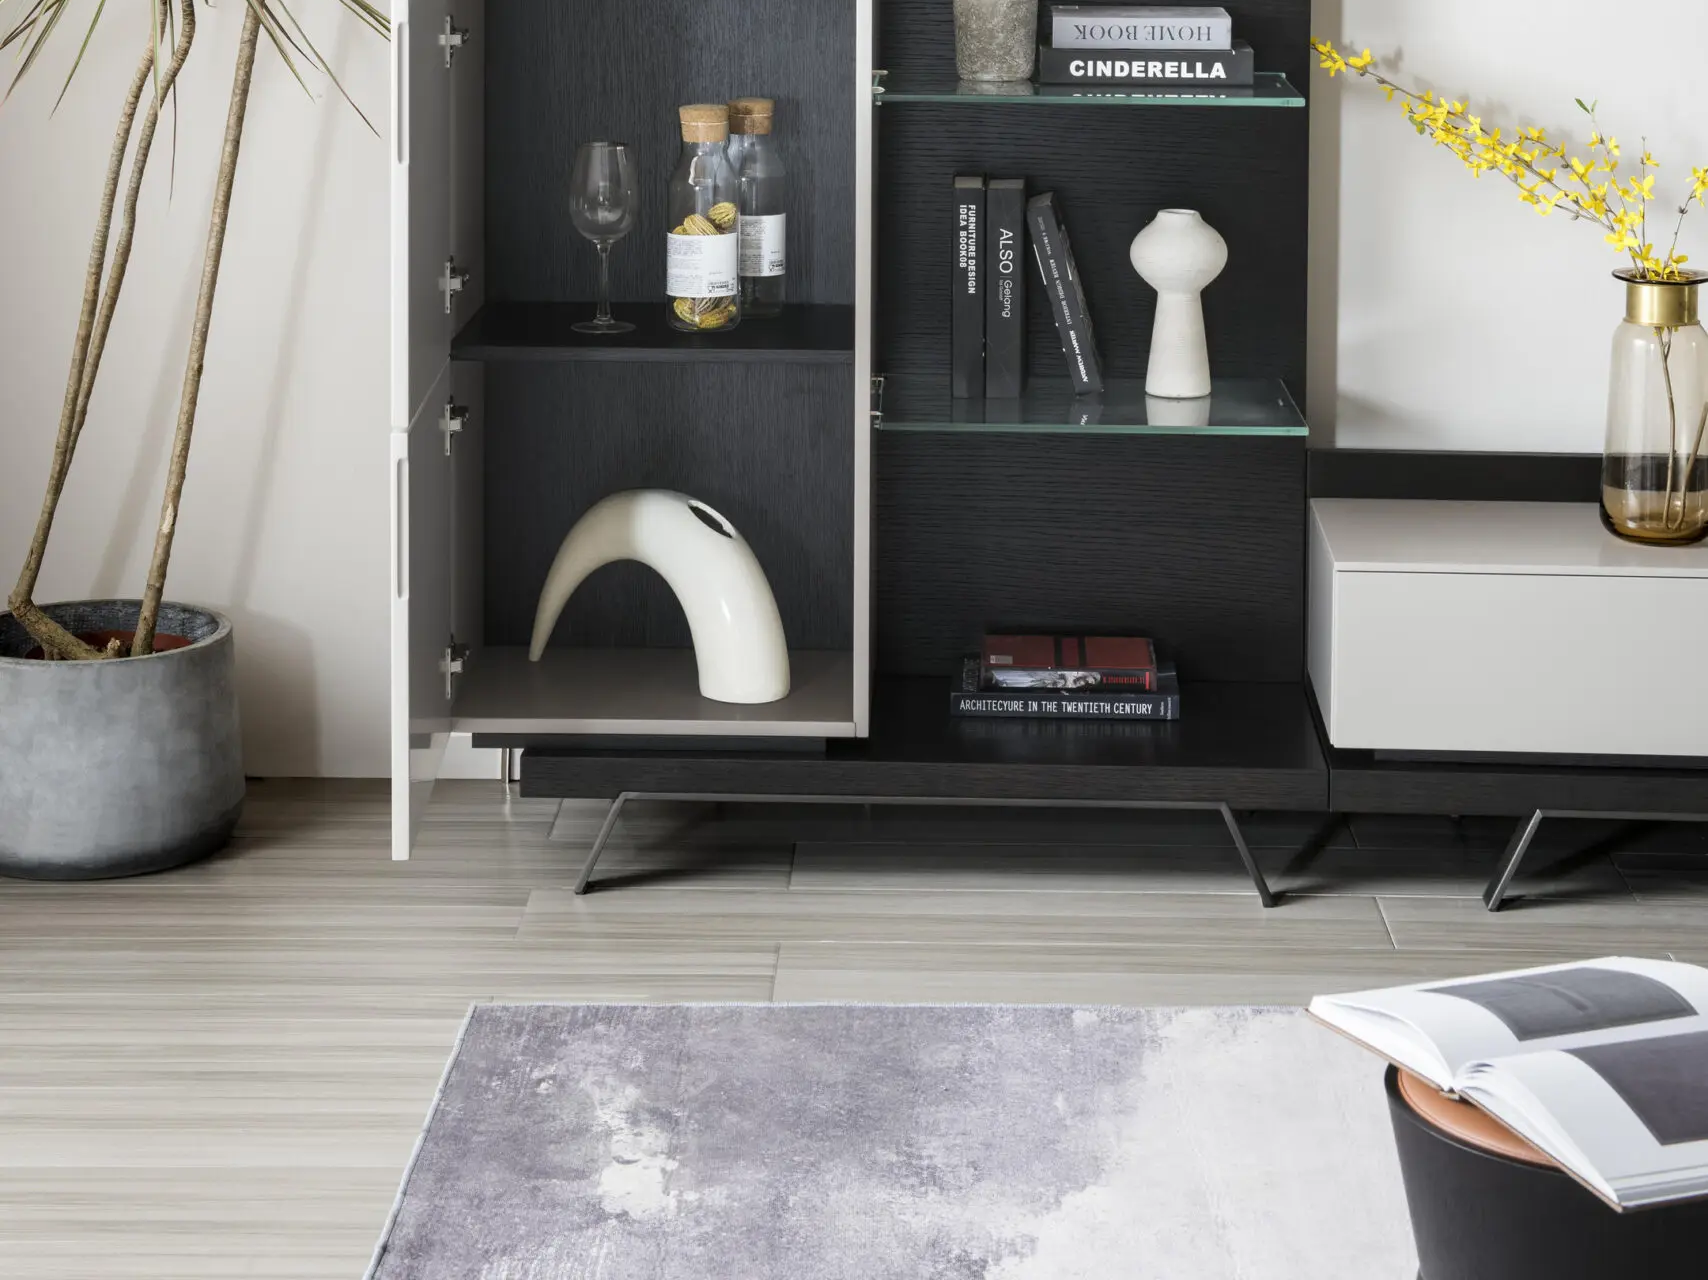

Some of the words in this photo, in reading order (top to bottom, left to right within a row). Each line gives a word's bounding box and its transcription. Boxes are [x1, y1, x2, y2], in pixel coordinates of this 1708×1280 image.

[1074, 24, 1138, 41] BOOK
[1144, 24, 1211, 41] HOME
[1069, 60, 1227, 79] CINDERELLA
[959, 204, 968, 227] IDEA
[968, 204, 976, 258] FURNITURE
[998, 228, 1014, 274] ALSO
[968, 259, 976, 294] DESIGN
[1002, 279, 1012, 318] Gelang
[1027, 700, 1038, 714] IN
[1041, 700, 1058, 715] THE
[1060, 700, 1111, 715] TWENTIETH
[1113, 701, 1153, 715] CENTURY
